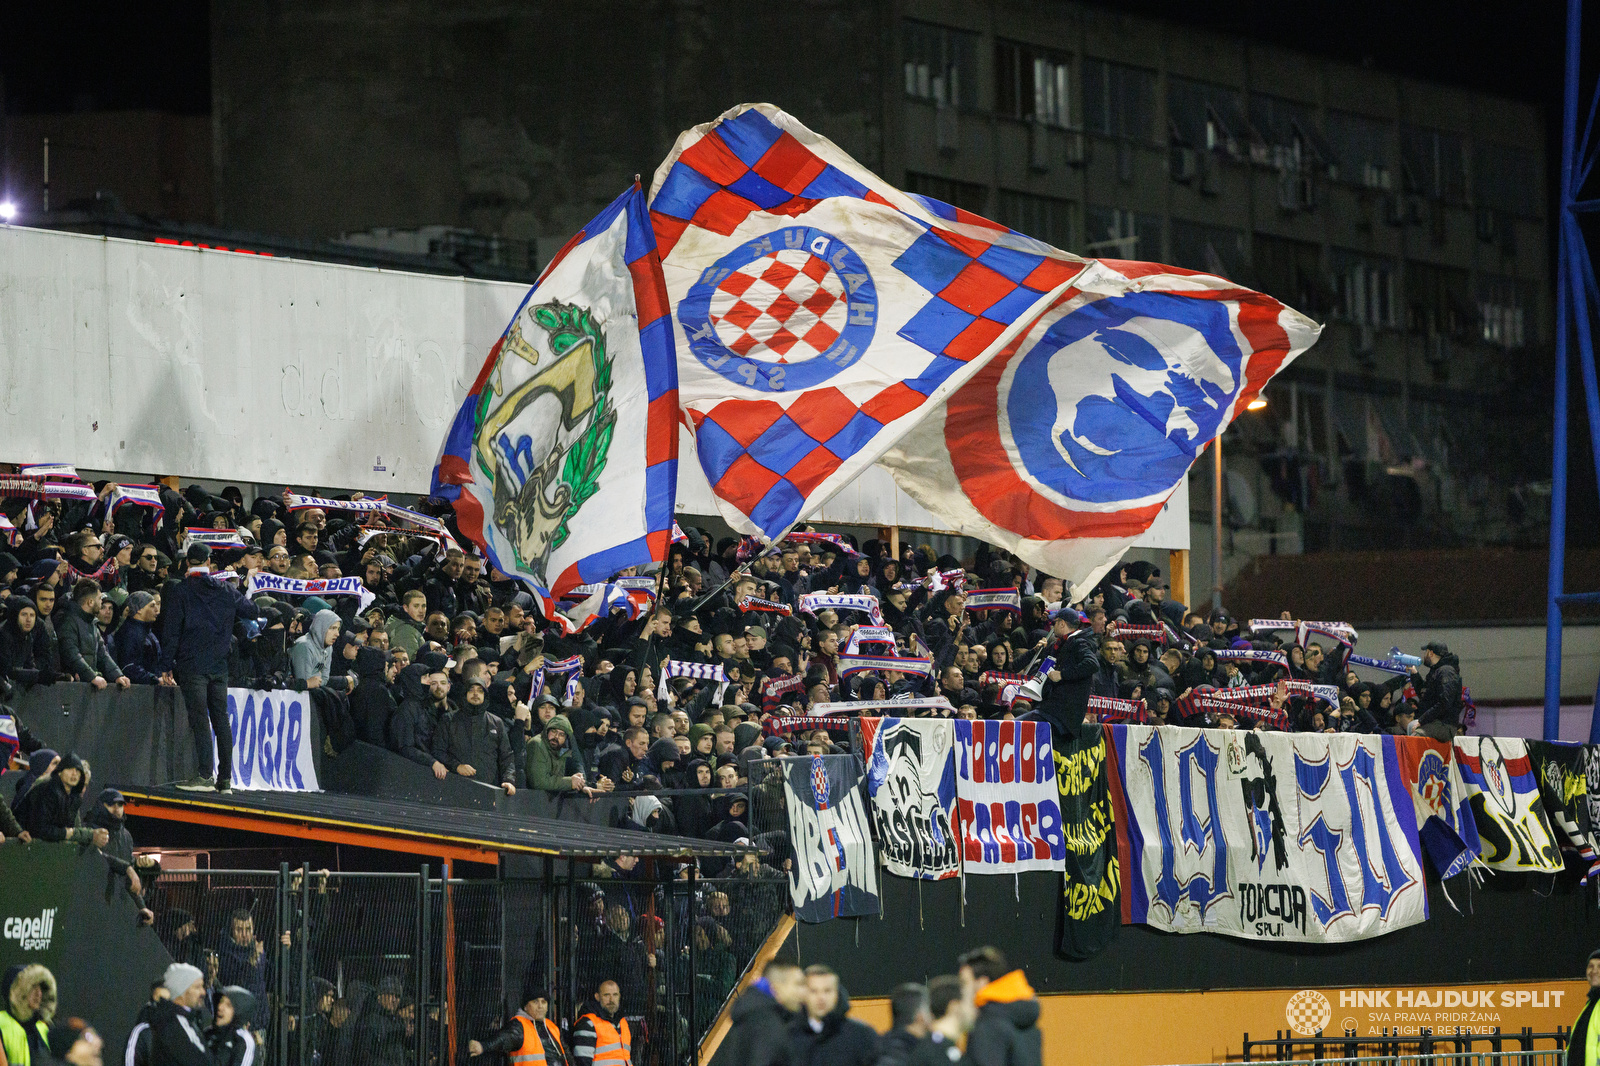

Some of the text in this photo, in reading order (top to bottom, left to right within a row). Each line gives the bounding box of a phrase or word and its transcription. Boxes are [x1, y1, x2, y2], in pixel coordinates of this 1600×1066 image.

[252, 576, 303, 591] WHITE
[1252, 651, 1283, 662] SPLIT
[1232, 689, 1248, 699] ŽIVI
[1249, 685, 1277, 697] VJEČNO
[1317, 687, 1338, 701] BOYS
[1202, 699, 1228, 710] HAJDUK
[955, 720, 1055, 785] TORCIDA
[958, 797, 1066, 865] ZAGREB
[1239, 883, 1307, 936] TORCDA
[4, 908, 55, 947] capelli
[24, 939, 51, 951] SPORT
